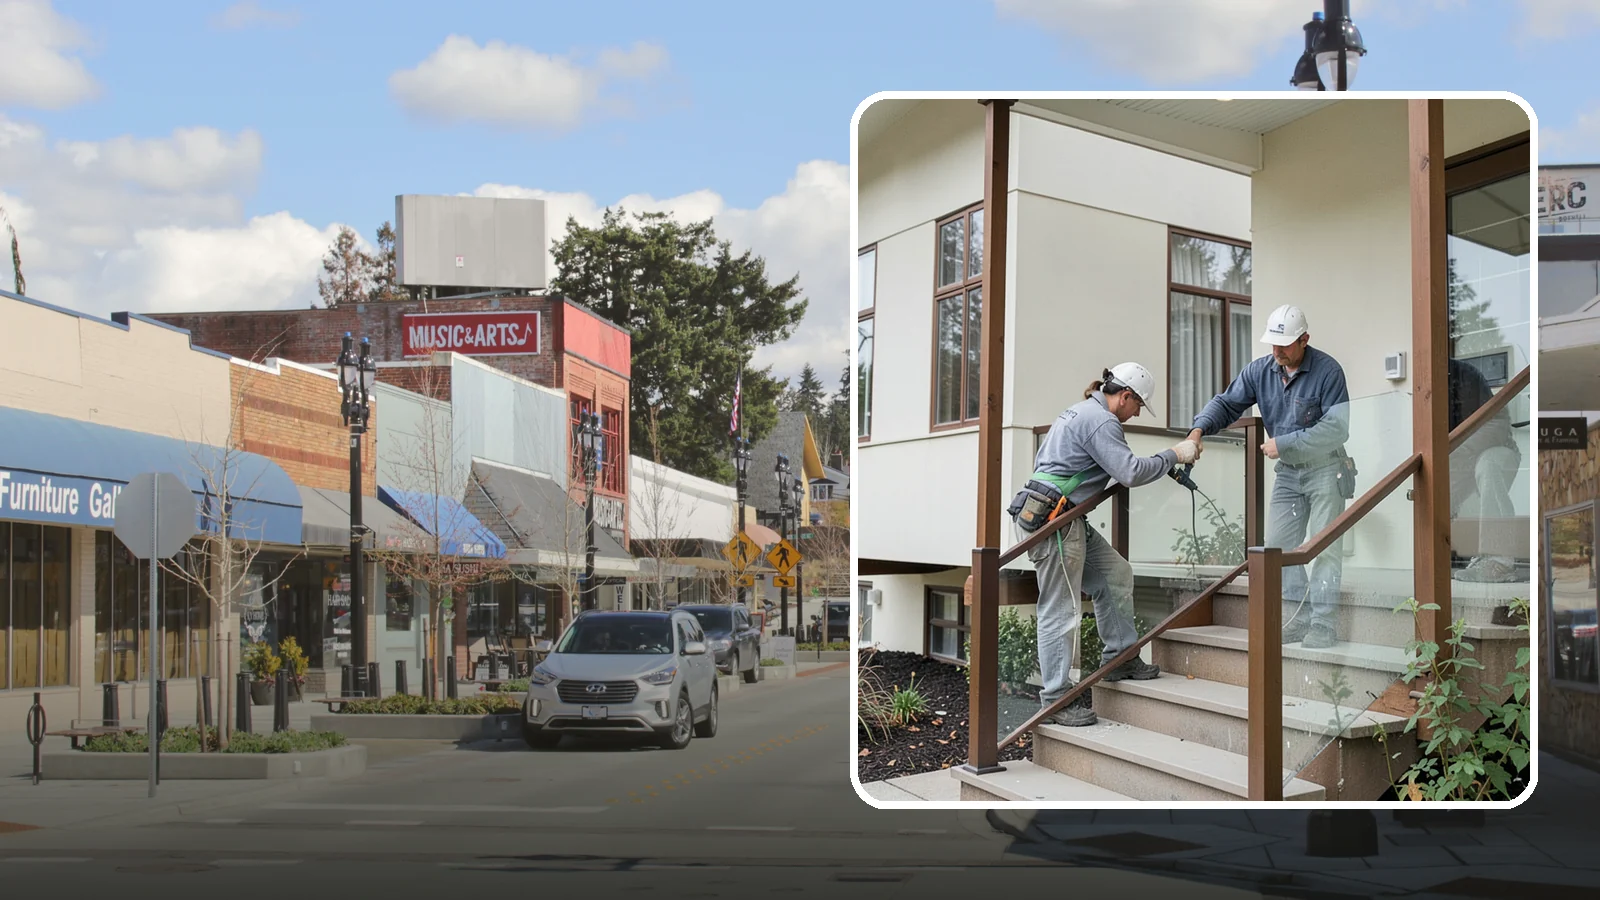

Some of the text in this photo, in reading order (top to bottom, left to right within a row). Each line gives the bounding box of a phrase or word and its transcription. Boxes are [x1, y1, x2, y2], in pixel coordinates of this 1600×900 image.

[0, 471, 121, 519] Furniture Gal
[454, 563, 479, 574] SUSHI
